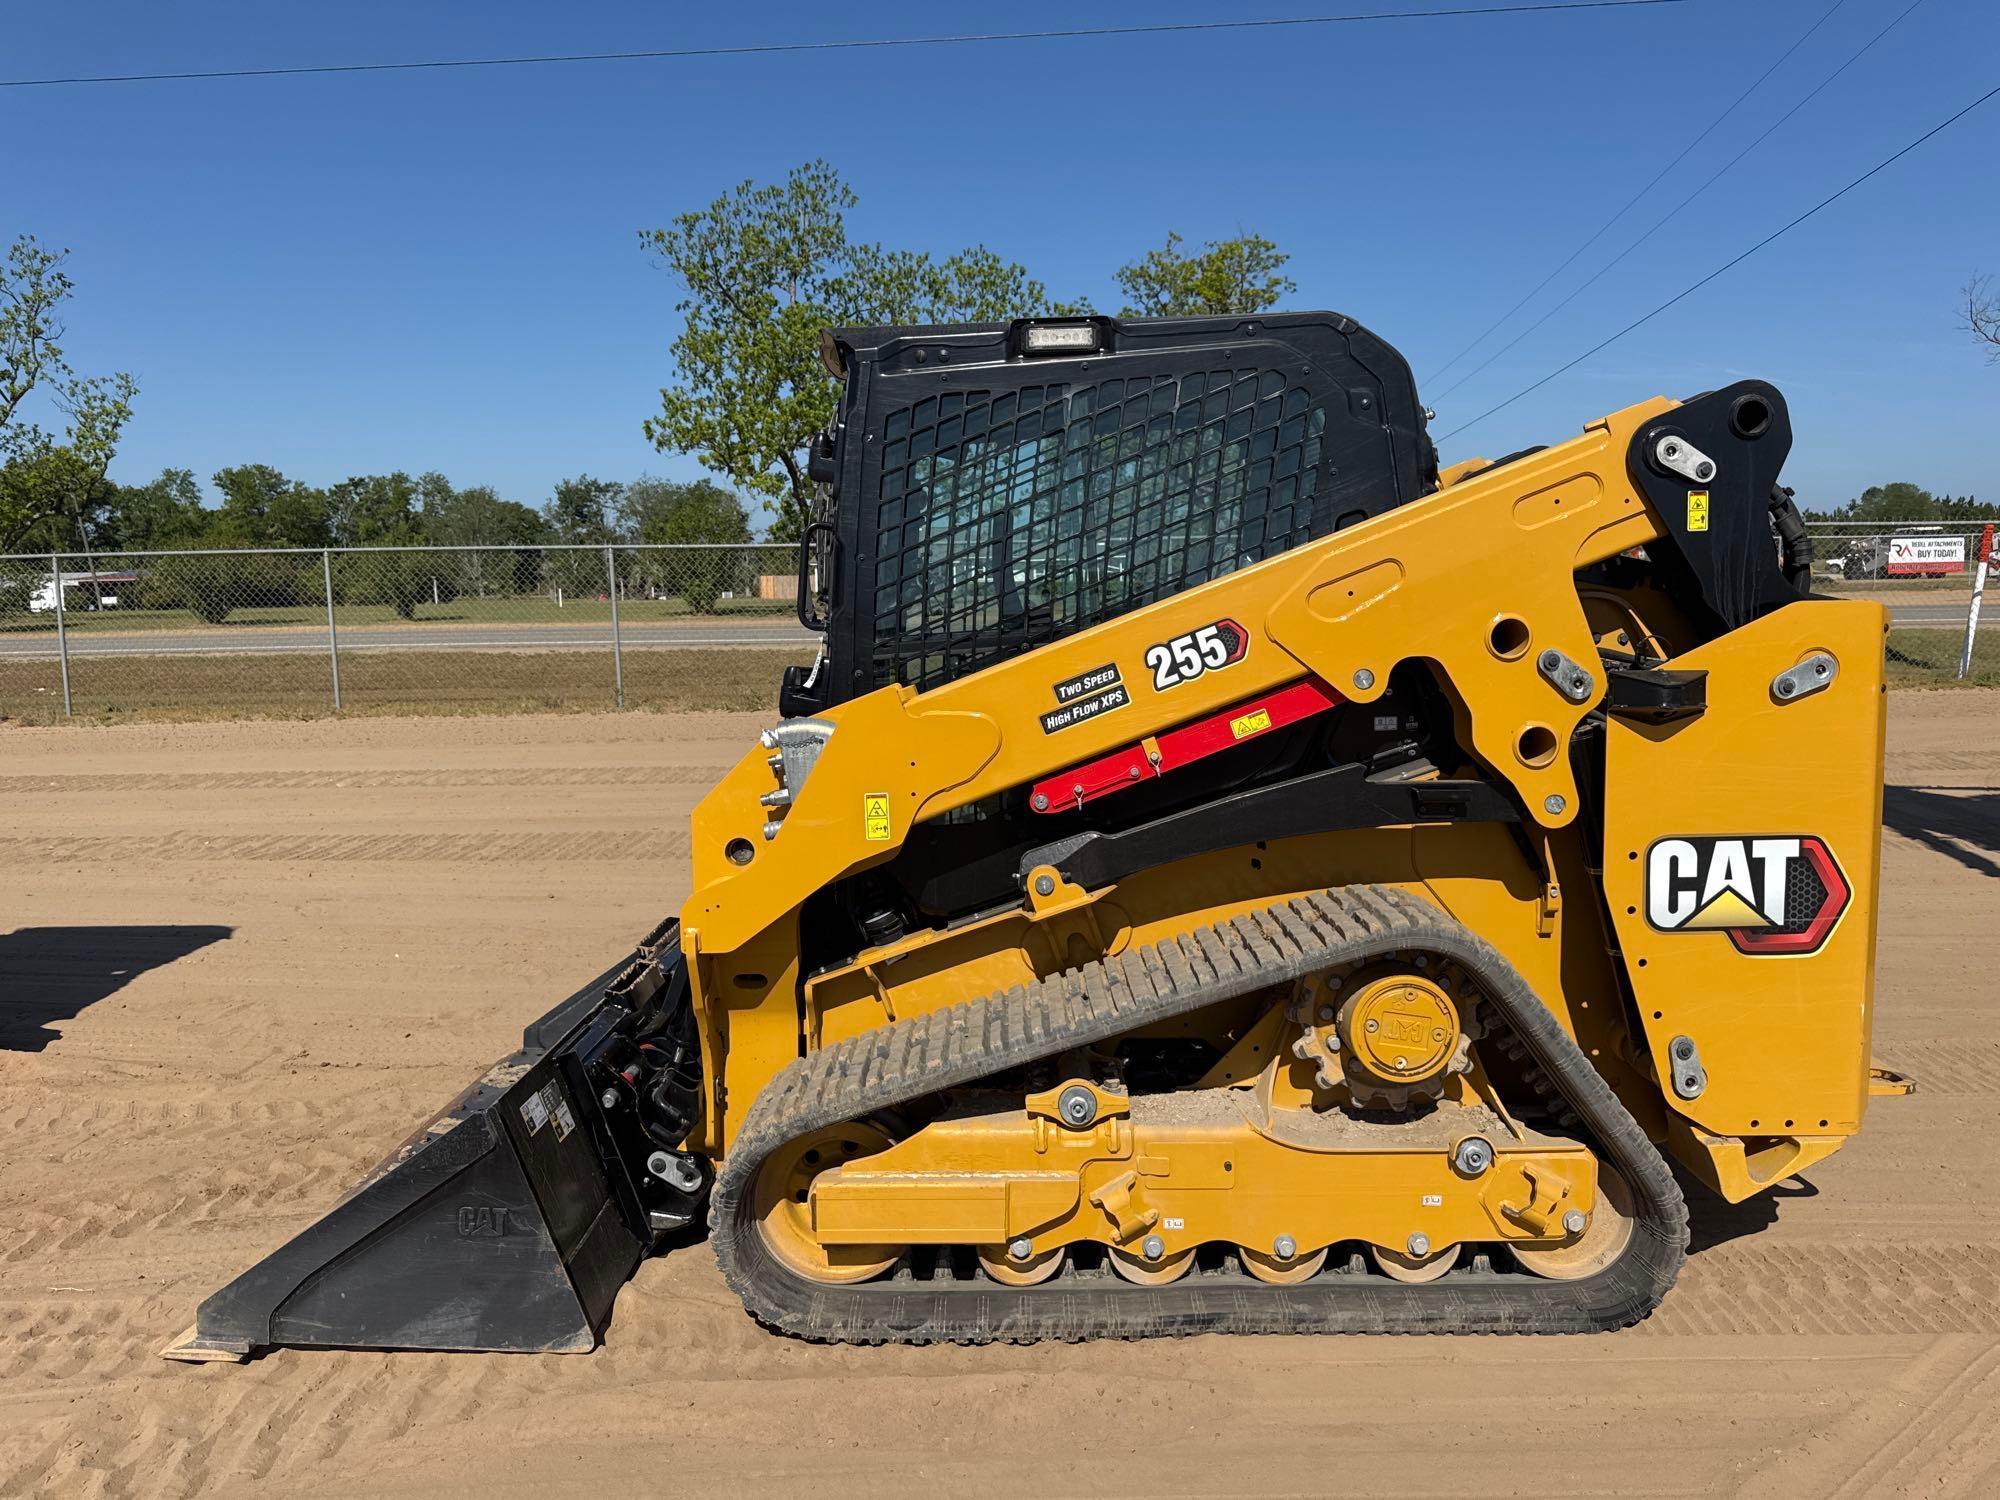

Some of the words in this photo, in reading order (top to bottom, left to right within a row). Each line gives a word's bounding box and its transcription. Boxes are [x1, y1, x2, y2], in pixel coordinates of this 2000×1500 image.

[1917, 550, 1931, 558] BUY
[1933, 549, 1957, 558] TODAY!
[1147, 625, 1227, 688] 255
[1101, 690, 1123, 708] XPS
[1650, 839, 1800, 928] CAT
[459, 1206, 507, 1237] CAT
